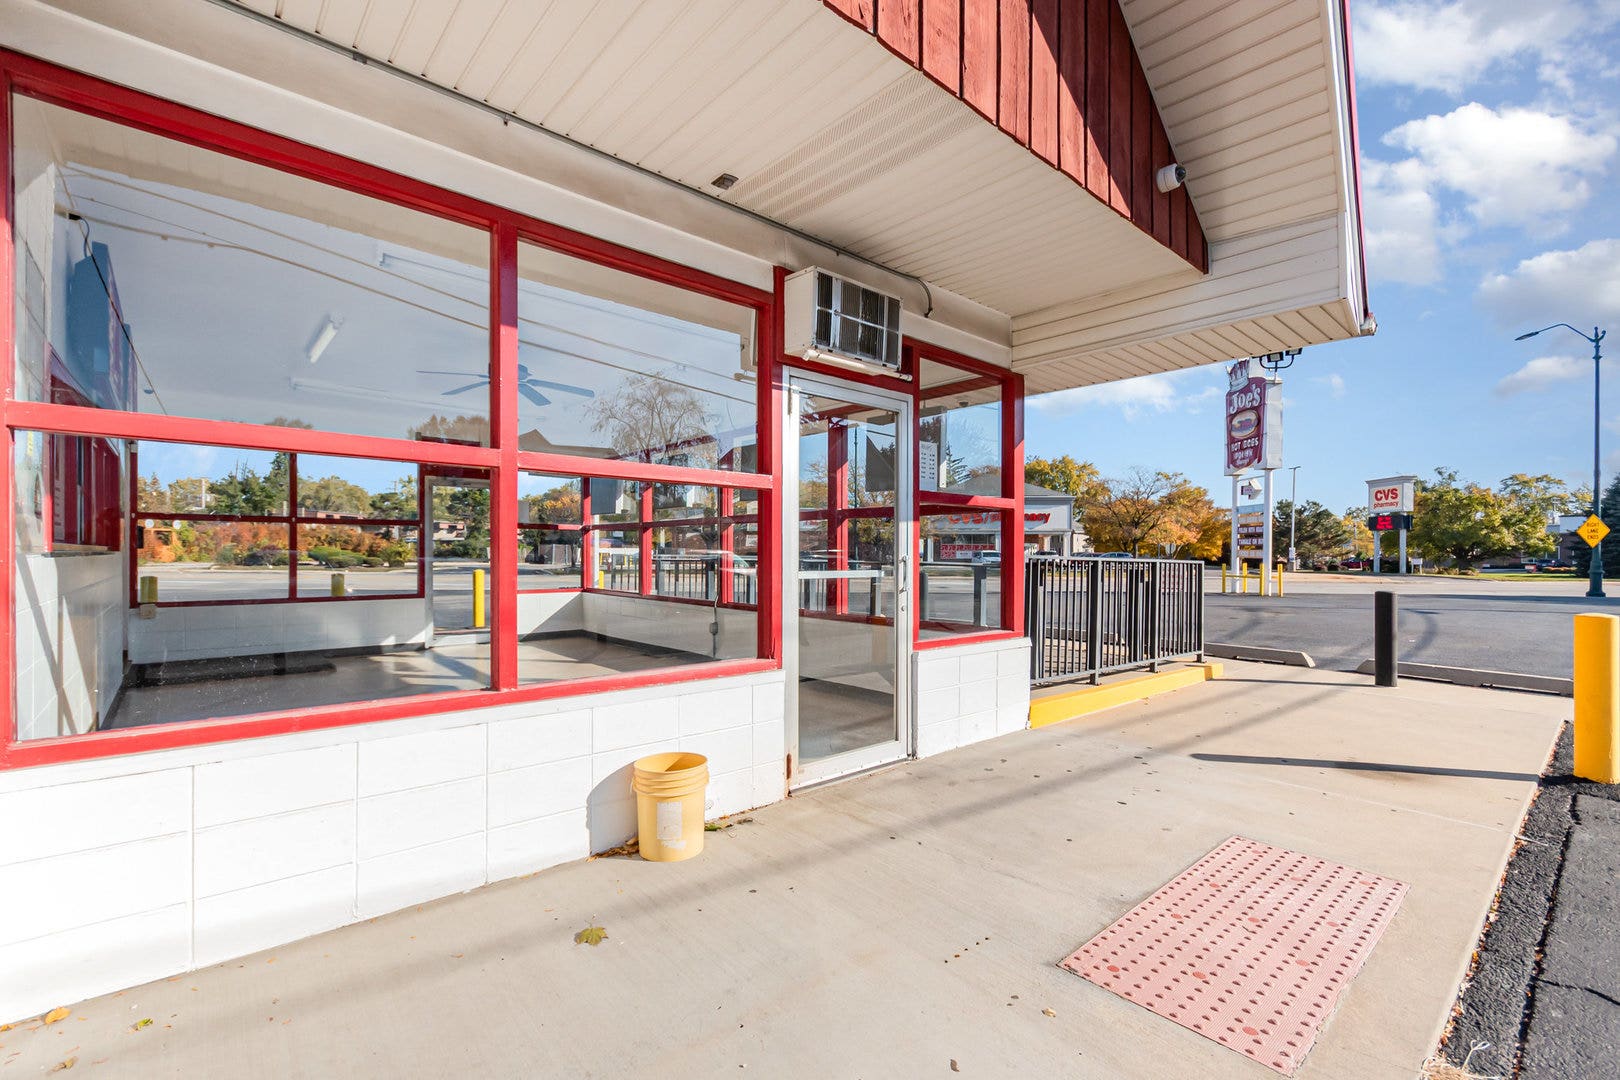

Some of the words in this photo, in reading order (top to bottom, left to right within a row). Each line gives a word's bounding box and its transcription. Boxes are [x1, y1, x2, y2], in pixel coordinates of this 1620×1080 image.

[1230, 383, 1261, 414] Joe's
[1374, 488, 1398, 501] CVS
[1373, 501, 1399, 509] pharmacy
